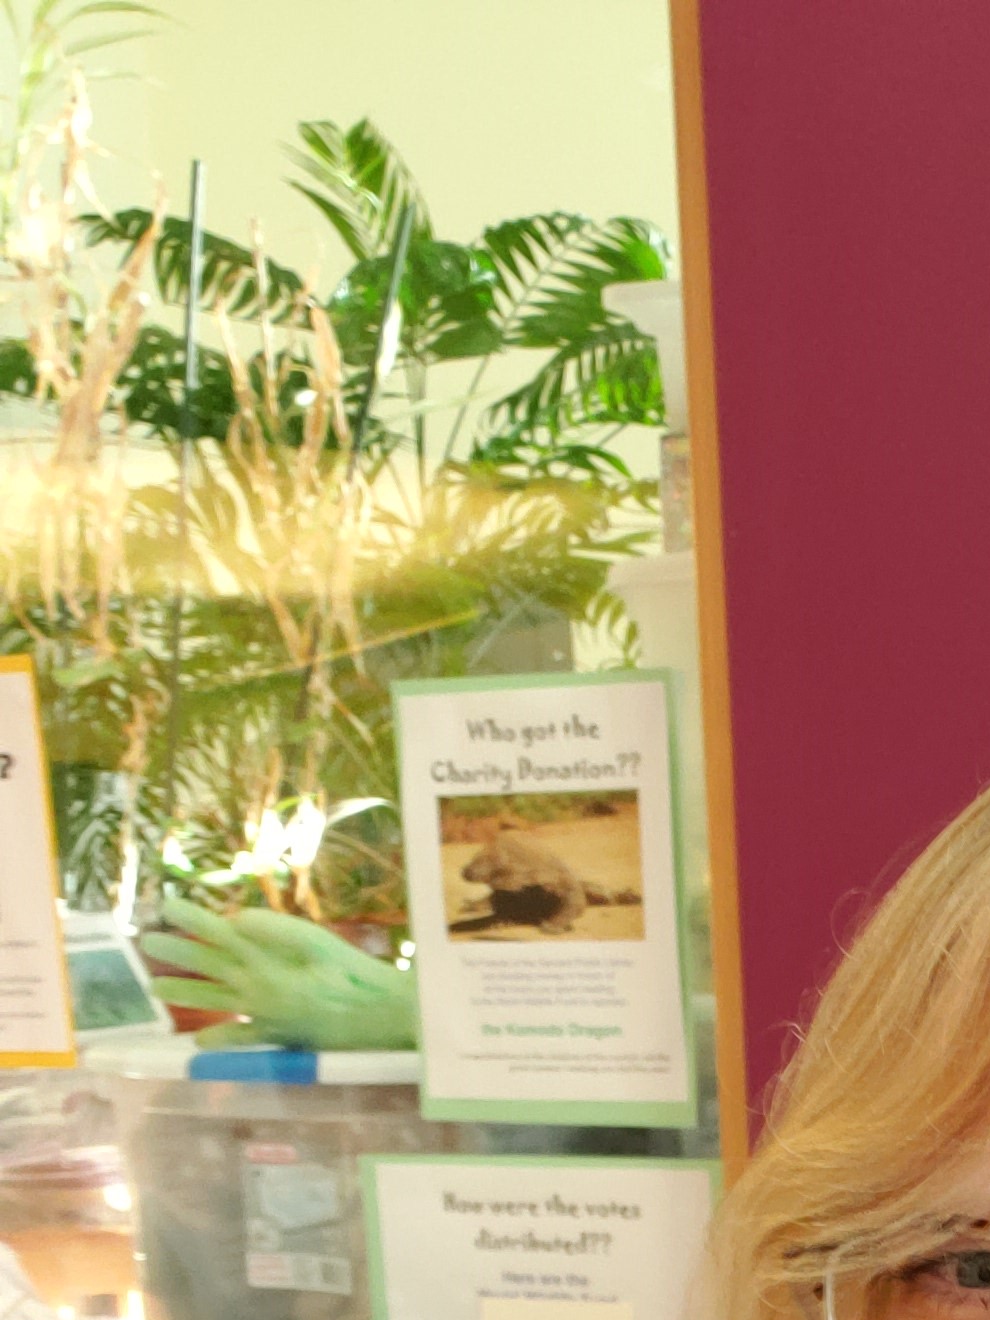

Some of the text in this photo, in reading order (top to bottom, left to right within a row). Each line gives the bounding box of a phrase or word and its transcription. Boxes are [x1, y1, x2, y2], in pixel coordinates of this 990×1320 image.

[466, 713, 600, 747] Who got the
[430, 751, 642, 790] Charity Donation??
[442, 1190, 642, 1220] How were the votes
[474, 1228, 613, 1255] distributed??
